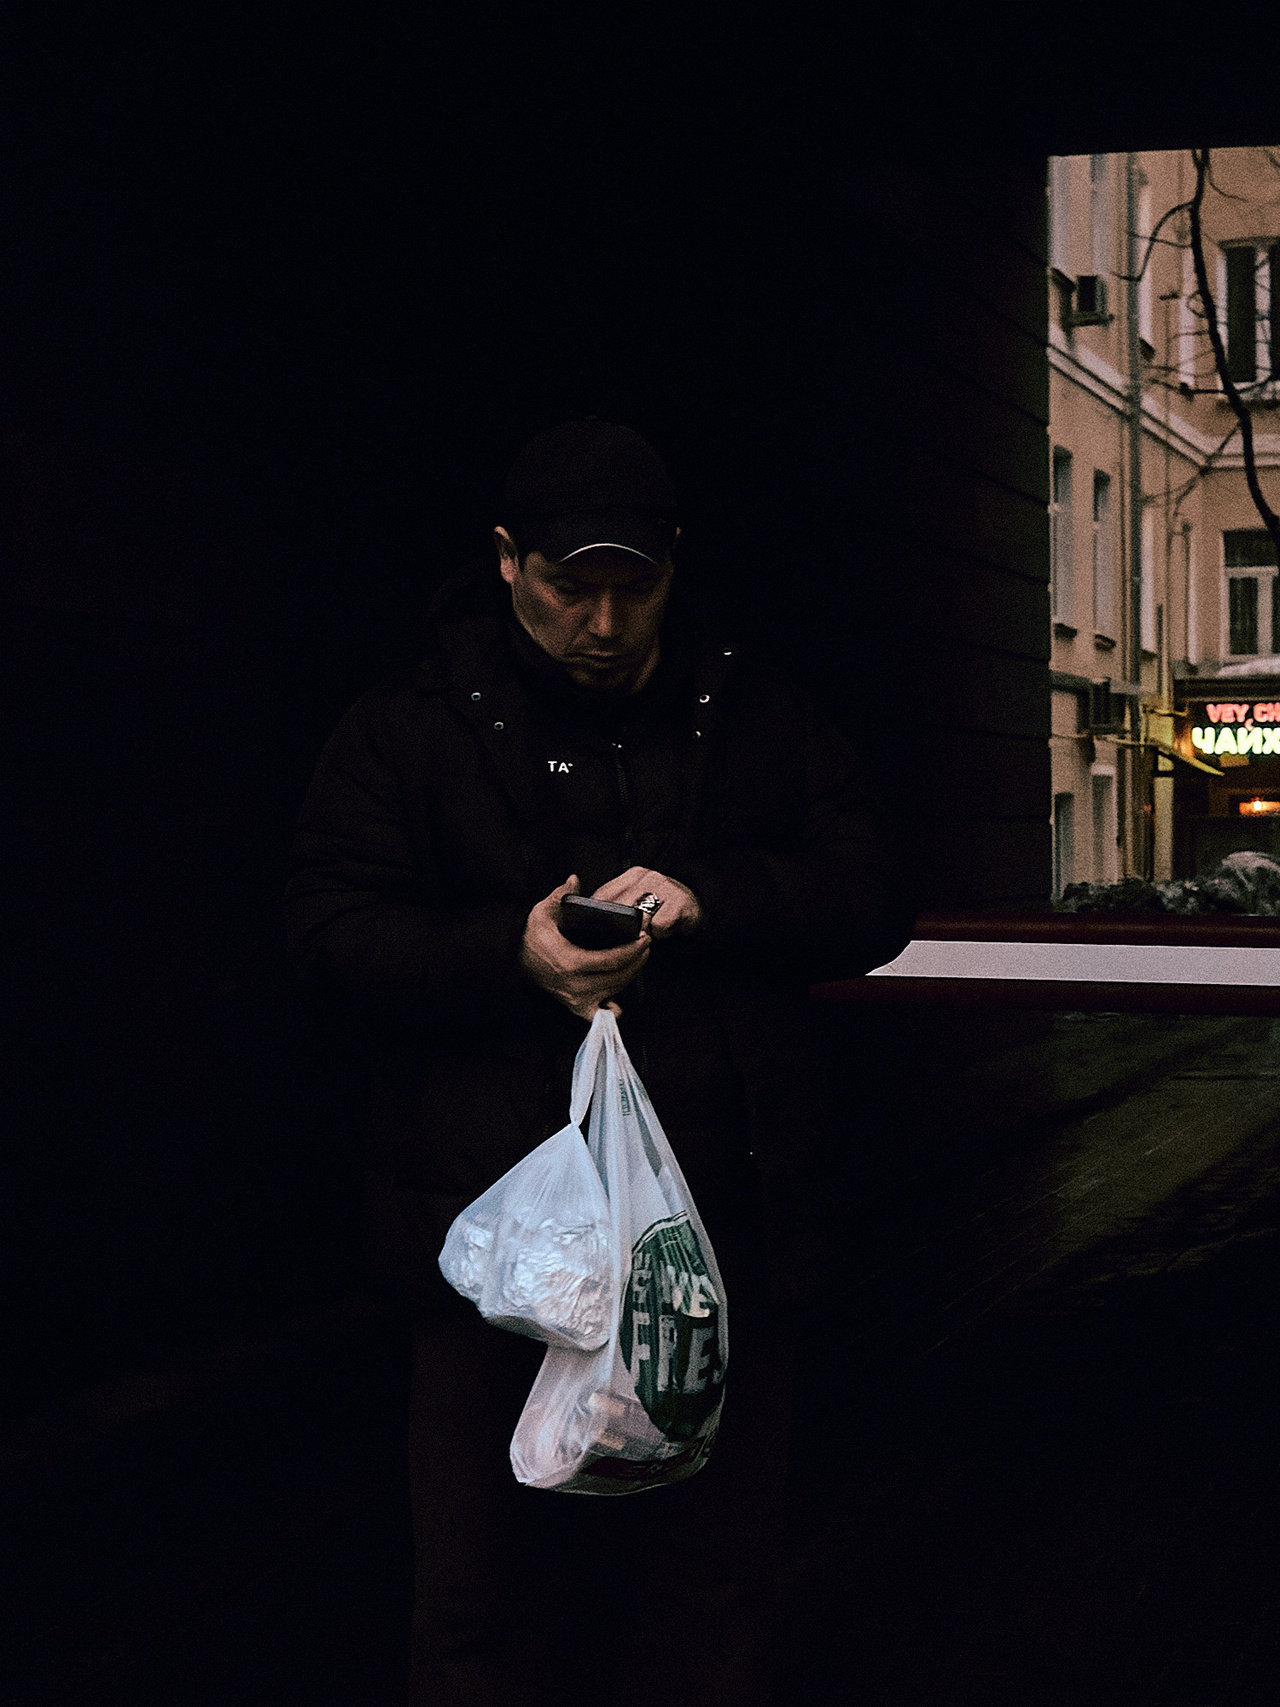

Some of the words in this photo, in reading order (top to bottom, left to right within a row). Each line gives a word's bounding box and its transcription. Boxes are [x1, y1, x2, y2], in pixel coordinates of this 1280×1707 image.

[1206, 703, 1249, 723] VEY
[547, 760, 574, 774] TA
[630, 1308, 721, 1395] FRE
